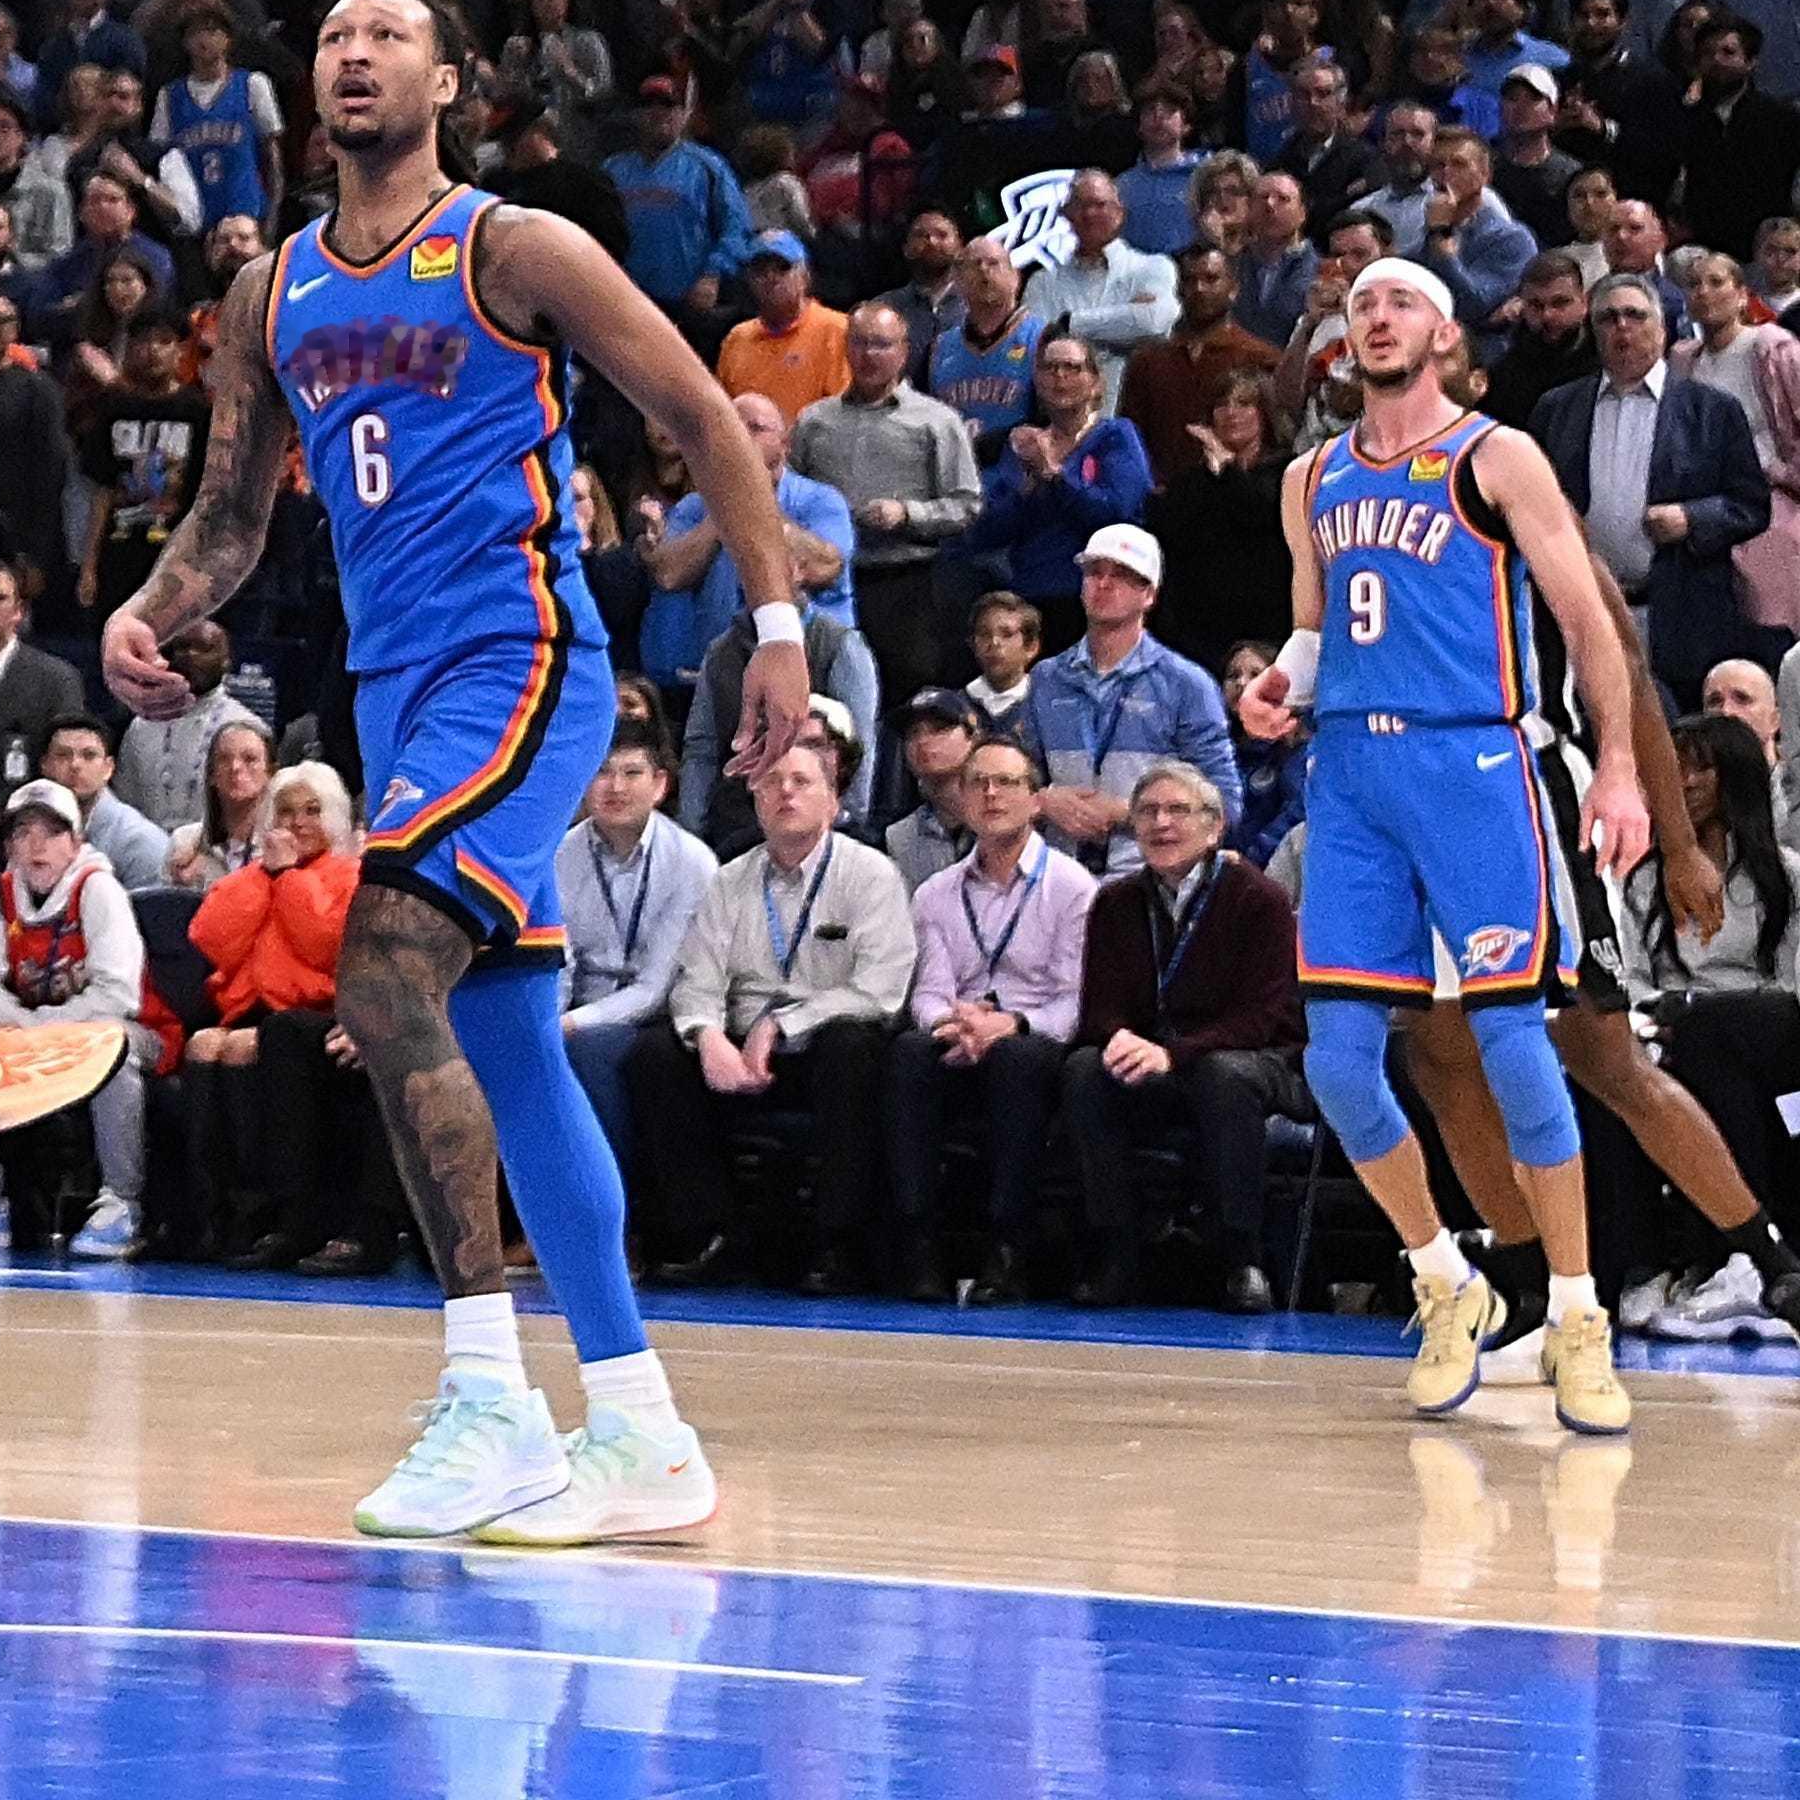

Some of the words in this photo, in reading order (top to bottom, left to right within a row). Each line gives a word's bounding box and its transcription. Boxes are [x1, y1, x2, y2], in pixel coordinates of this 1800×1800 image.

[350, 412, 393, 509] 6
[1311, 497, 1455, 566] HUNDER
[1349, 569, 1386, 645] 9
